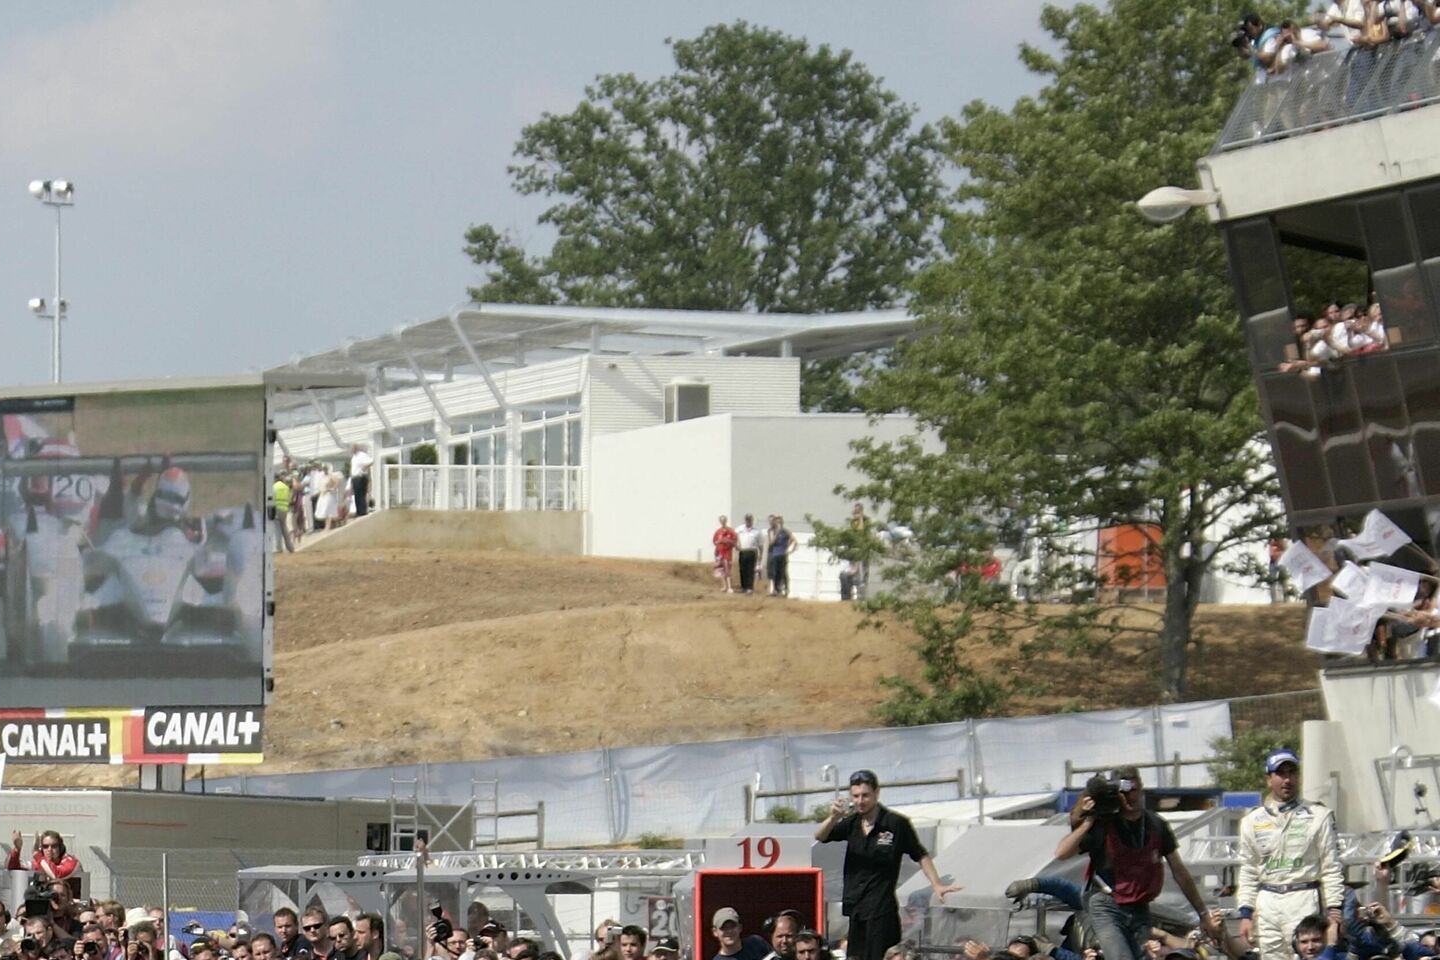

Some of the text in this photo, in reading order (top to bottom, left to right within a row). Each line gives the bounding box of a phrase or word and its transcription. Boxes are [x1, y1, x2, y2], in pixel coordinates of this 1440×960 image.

[55, 473, 93, 501] 20
[1, 722, 107, 757] CANAL+
[147, 711, 260, 745] CANAL+
[737, 836, 781, 870] 19
